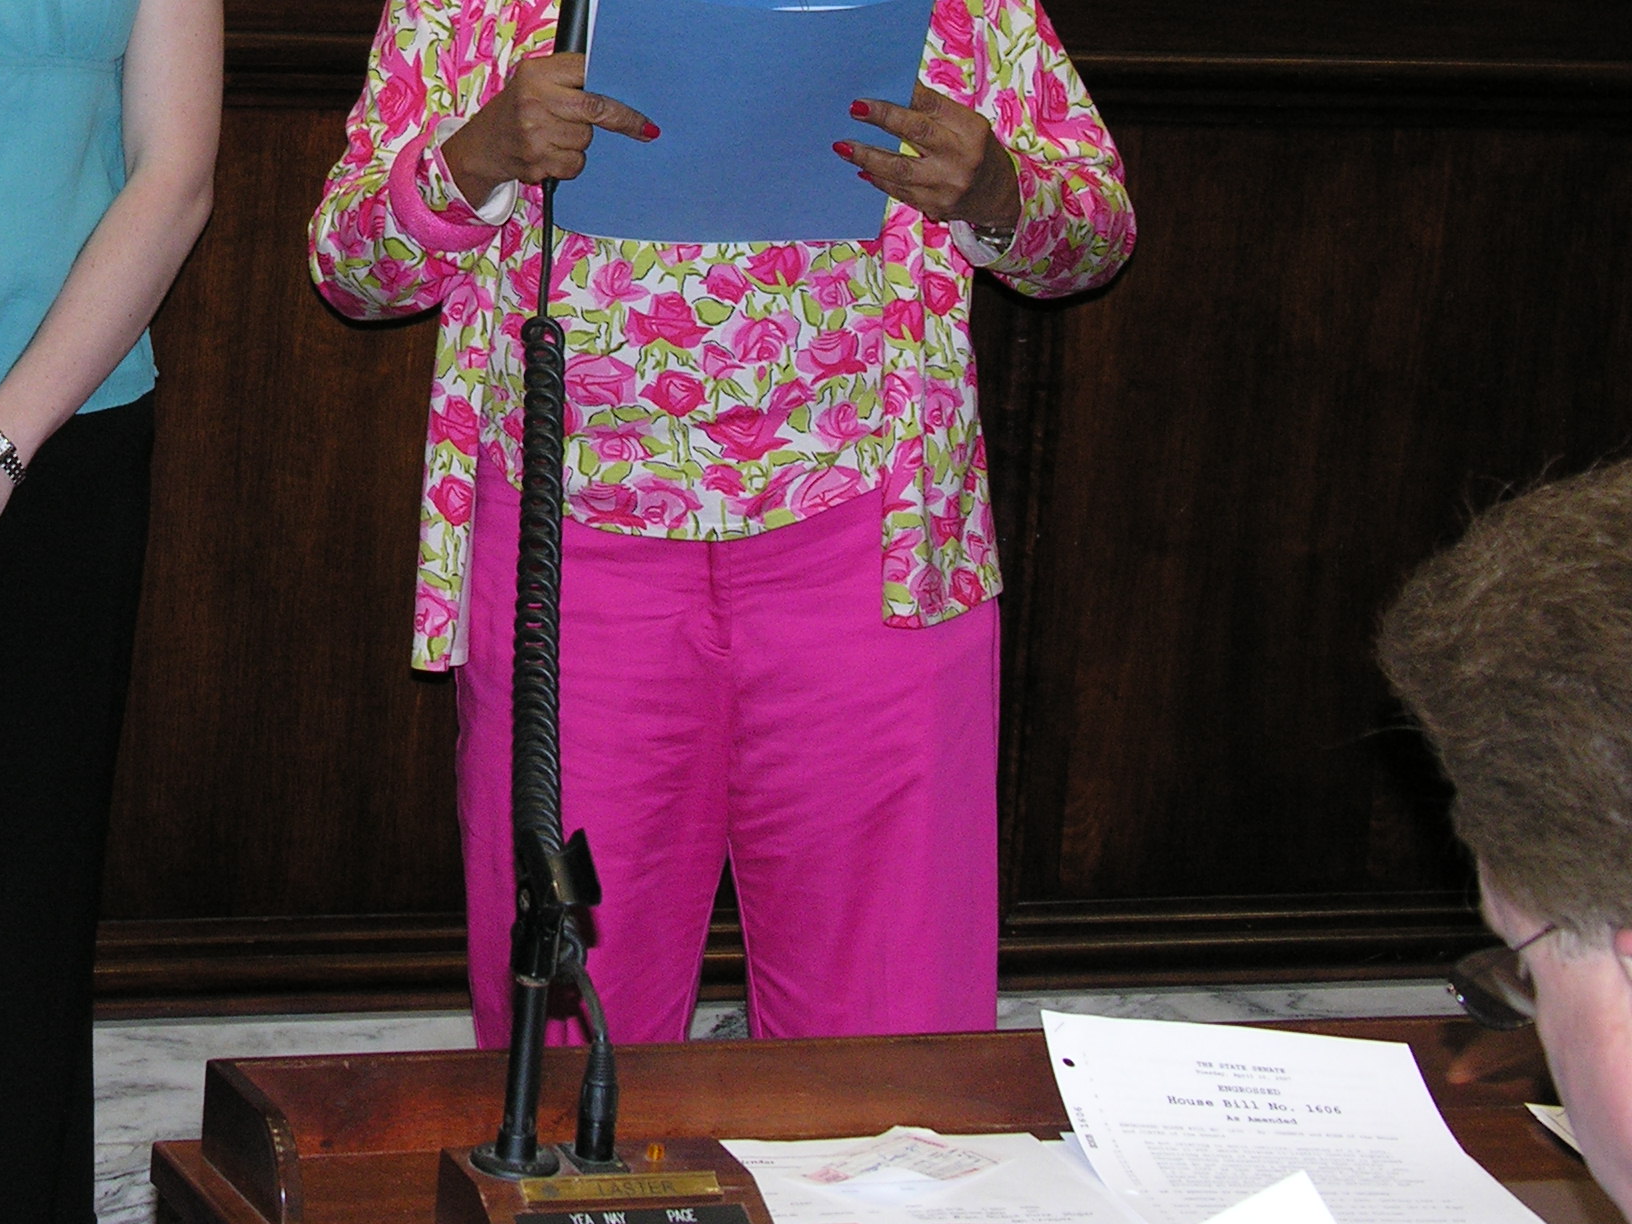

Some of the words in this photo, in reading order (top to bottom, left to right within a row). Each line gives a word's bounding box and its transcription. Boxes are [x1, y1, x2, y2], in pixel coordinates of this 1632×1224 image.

[1252, 1066, 1286, 1074] SENATE
[1217, 1084, 1281, 1096] ENGROSSED
[1167, 1095, 1214, 1108] House
[1223, 1100, 1259, 1111] Bill
[1268, 1102, 1294, 1113] No.
[1306, 1104, 1342, 1116] 1606
[1226, 1114, 1241, 1123] As
[1248, 1116, 1298, 1126] Amended
[597, 1181, 677, 1197] LASTER
[603, 1211, 626, 1224] NAY
[667, 1209, 697, 1223] PAGE
